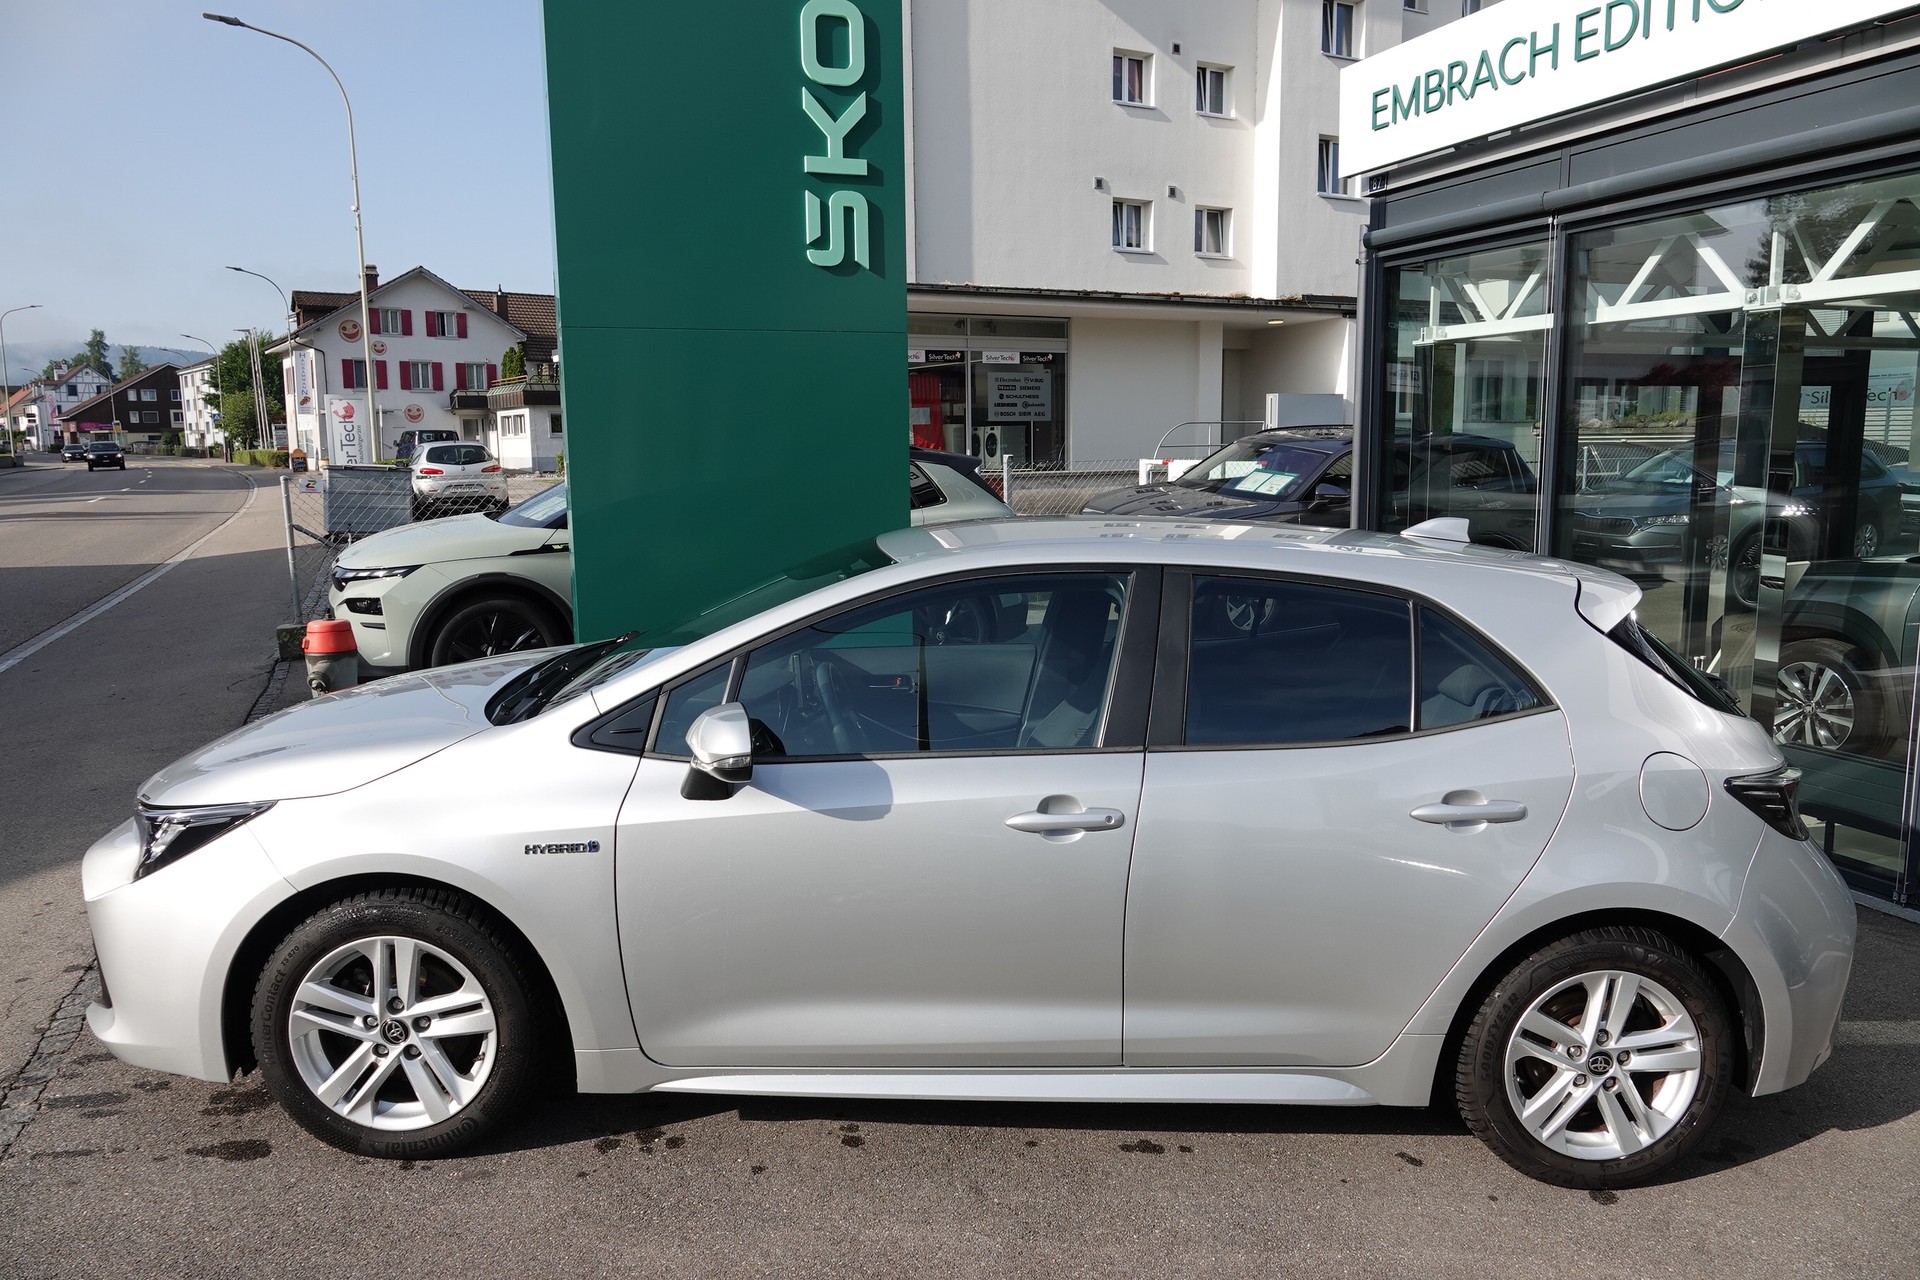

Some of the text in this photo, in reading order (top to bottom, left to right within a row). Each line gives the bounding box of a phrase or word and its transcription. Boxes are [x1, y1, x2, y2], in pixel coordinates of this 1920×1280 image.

[1372, 23, 1560, 131] EMBRACH
[1372, 177, 1382, 190] 87
[524, 843, 588, 855] HYBRID
